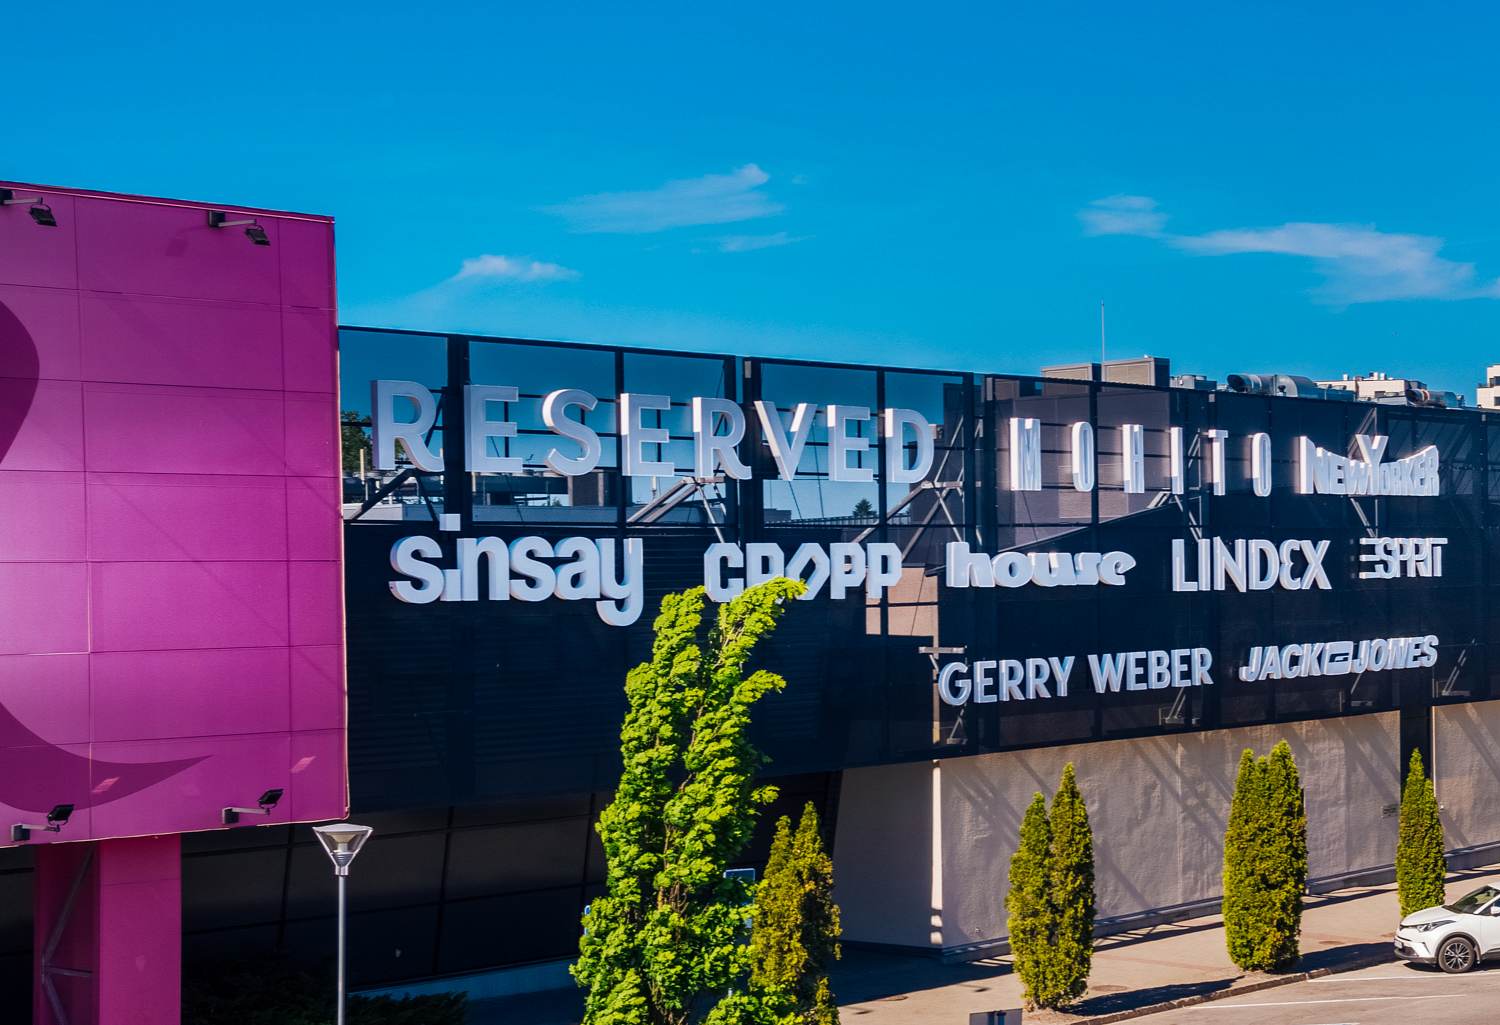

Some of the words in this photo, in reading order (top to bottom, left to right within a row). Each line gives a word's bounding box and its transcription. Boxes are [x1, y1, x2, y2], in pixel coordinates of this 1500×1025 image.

[371, 379, 935, 484] RESERVED
[1010, 417, 1272, 497] MOHITO
[946, 541, 1136, 588] house
[1172, 536, 1332, 592] LINDEX
[1359, 537, 1448, 579] ESPRIT
[938, 656, 1075, 706] GERRY
[1088, 647, 1213, 694] WEBER
